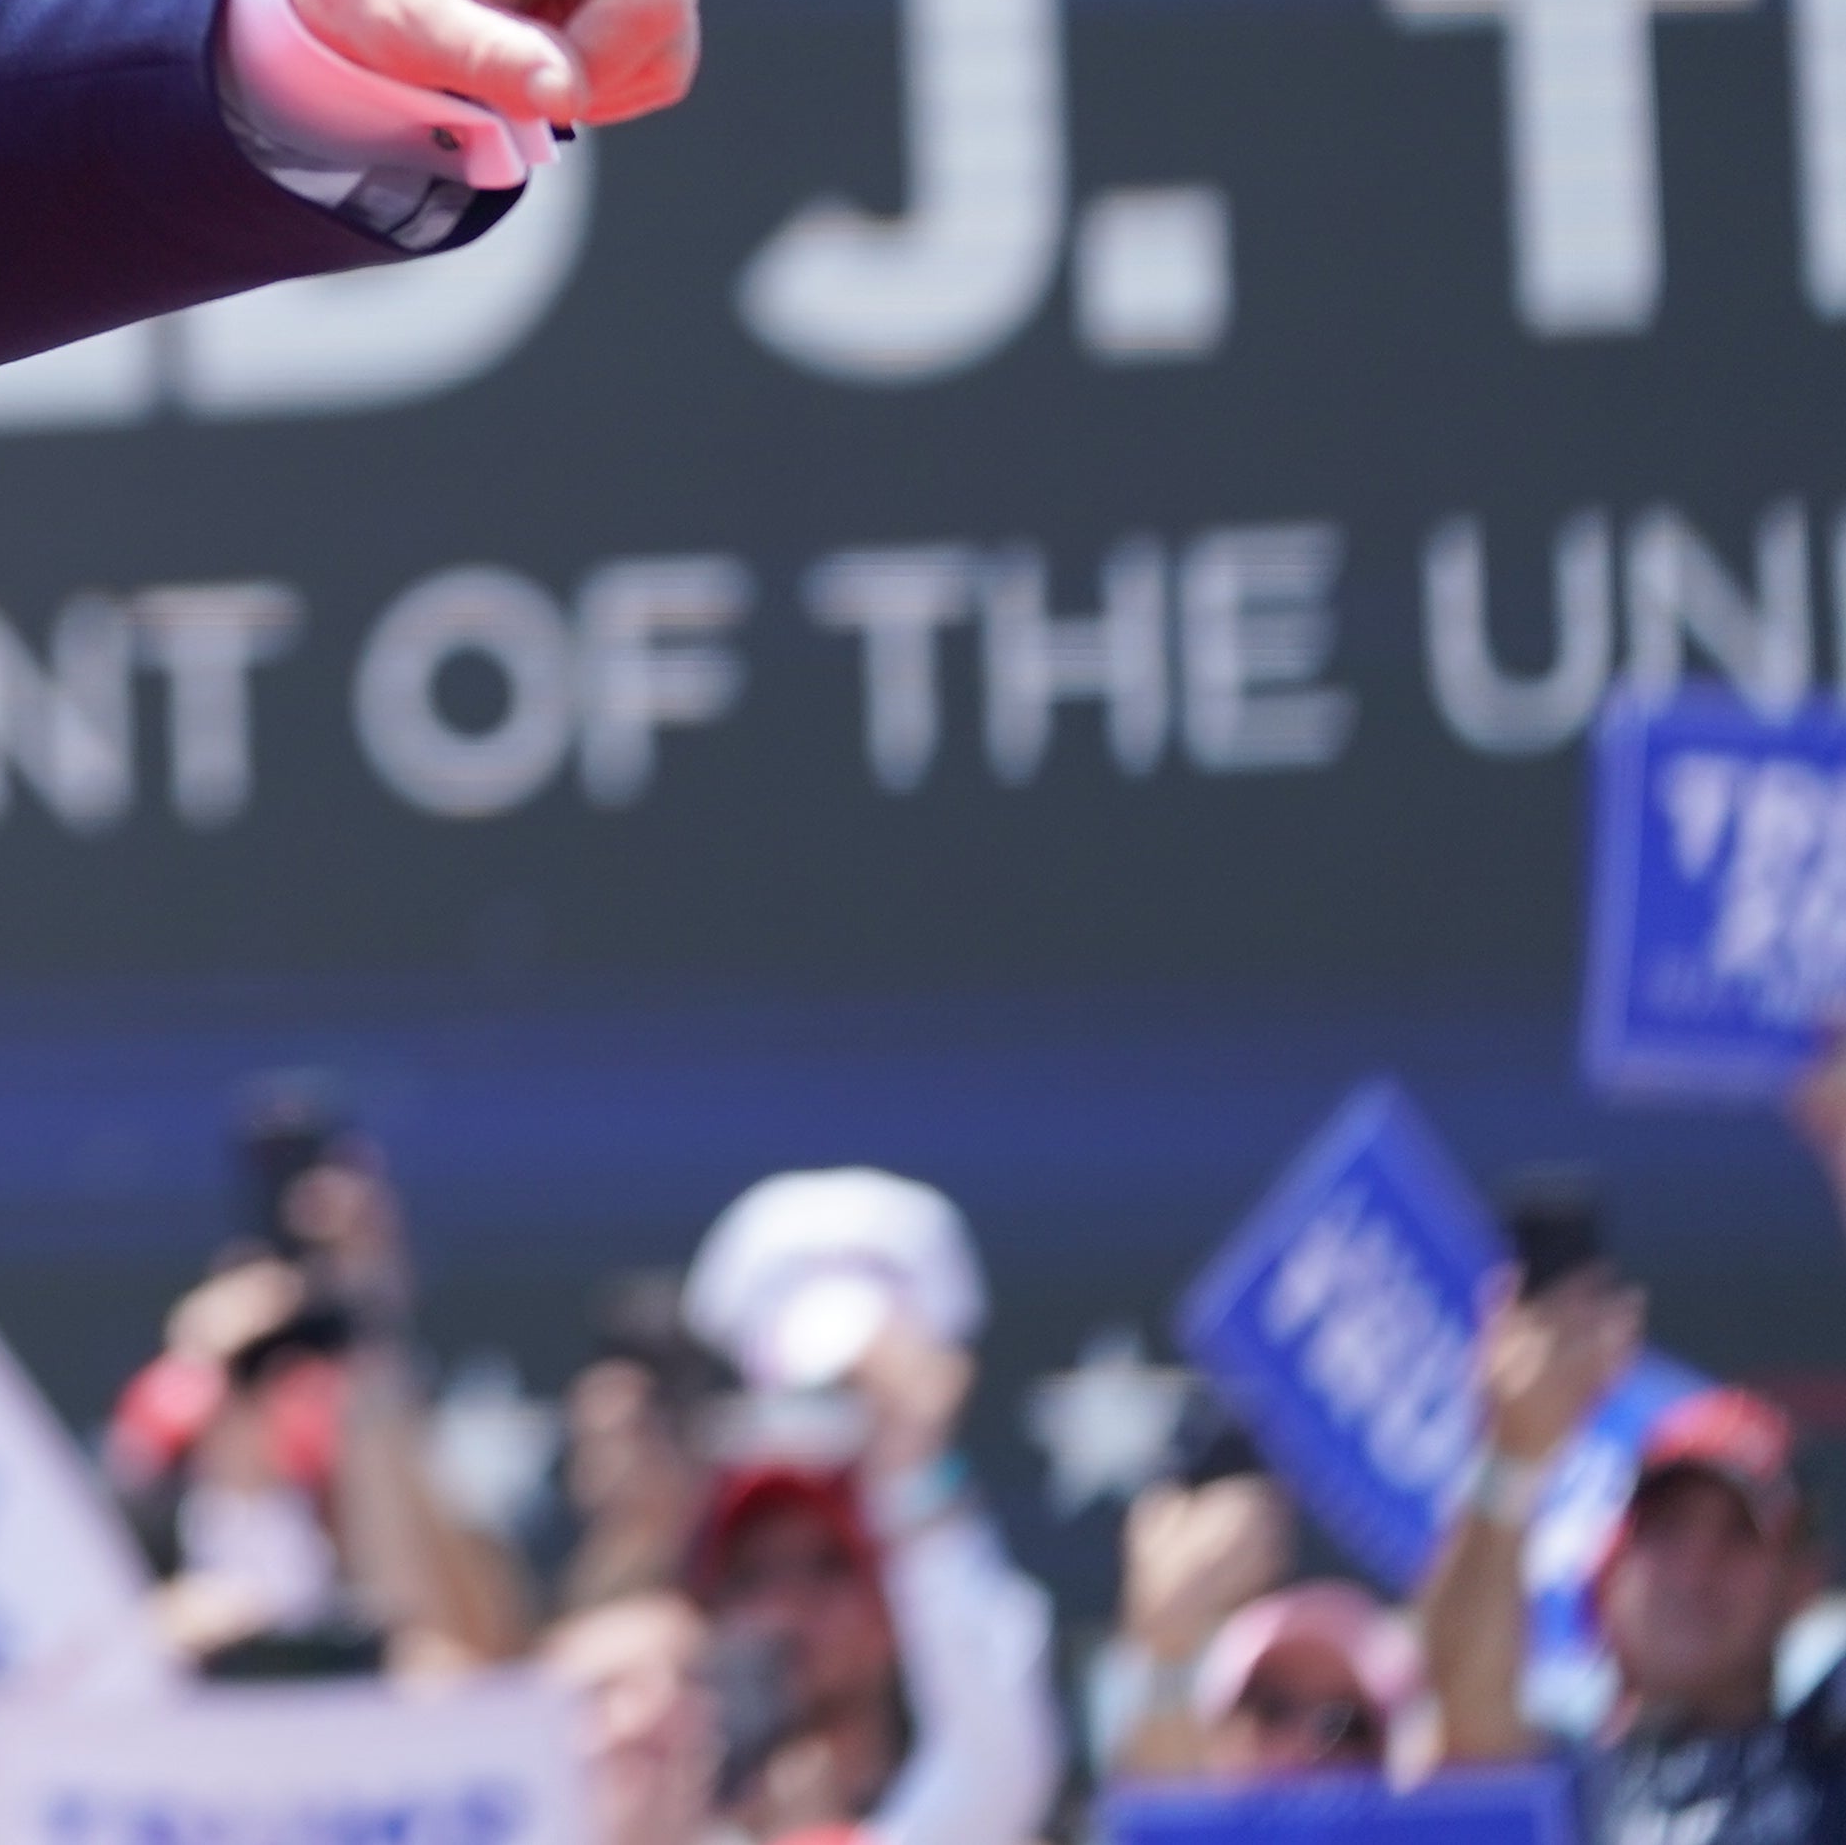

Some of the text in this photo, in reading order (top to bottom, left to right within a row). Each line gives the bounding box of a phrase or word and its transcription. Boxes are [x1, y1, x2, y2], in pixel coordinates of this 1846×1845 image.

[351, 554, 749, 818] OF
[799, 520, 1353, 794] THE
[1422, 497, 1846, 760] UN
